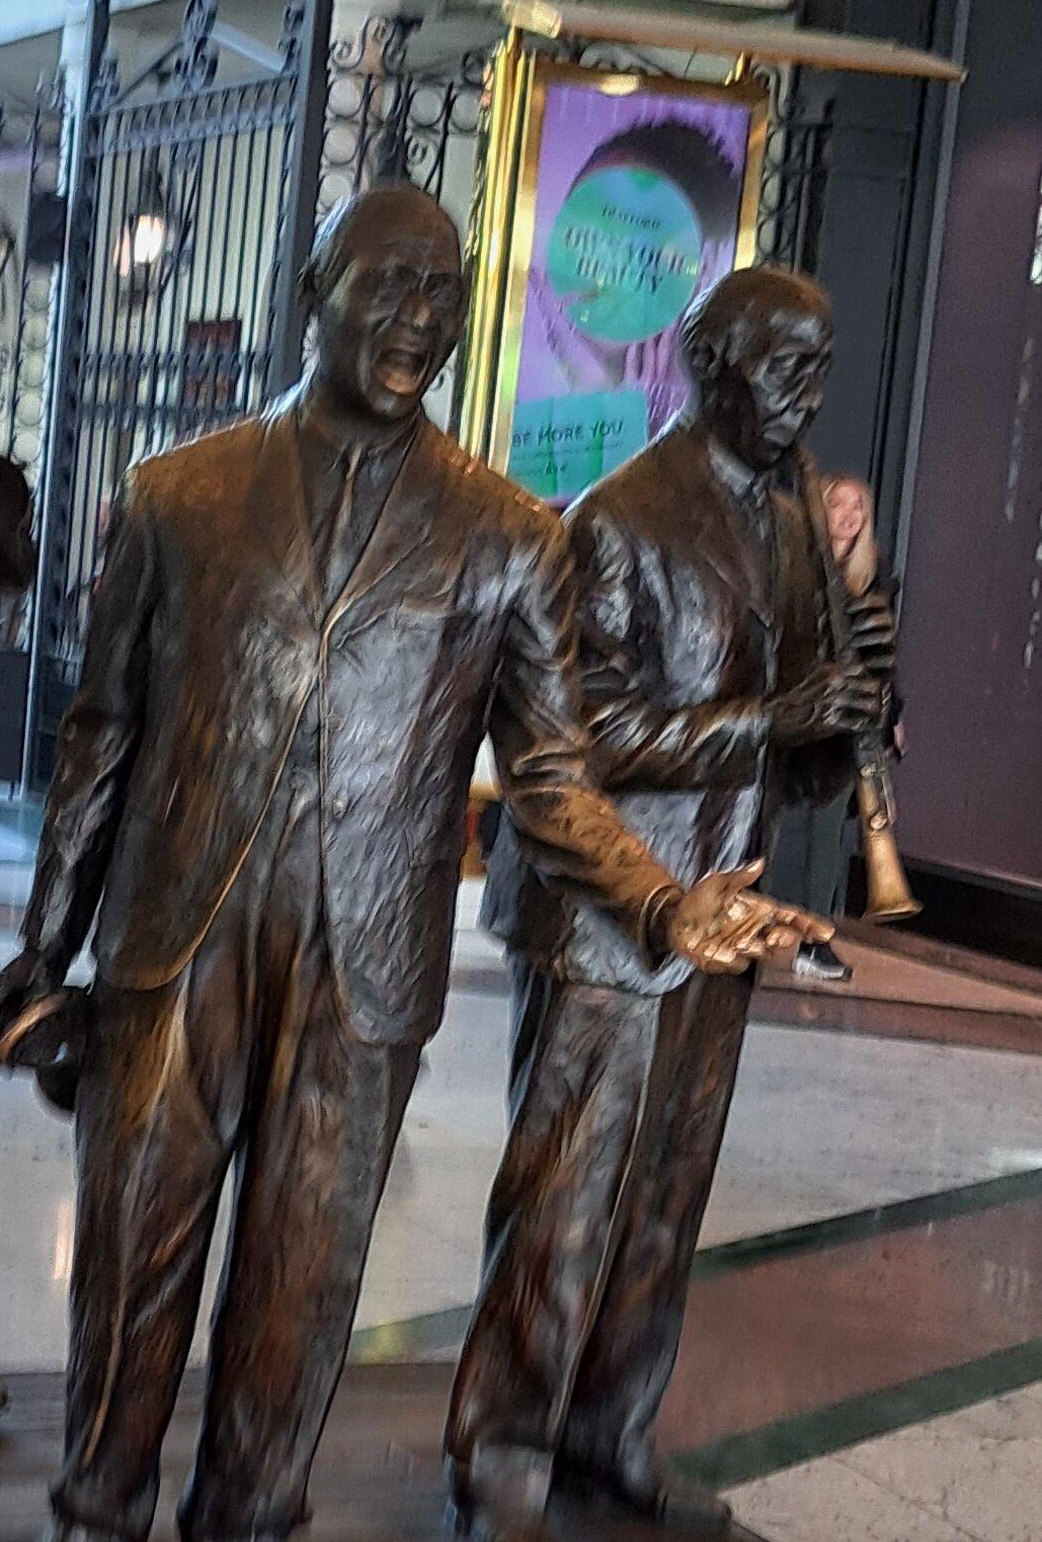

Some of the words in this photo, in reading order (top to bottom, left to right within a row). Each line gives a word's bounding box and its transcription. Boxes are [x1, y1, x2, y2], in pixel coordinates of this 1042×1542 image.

[512, 431, 532, 447] BE
[537, 421, 586, 446] MORE
[590, 418, 625, 439] YOU
